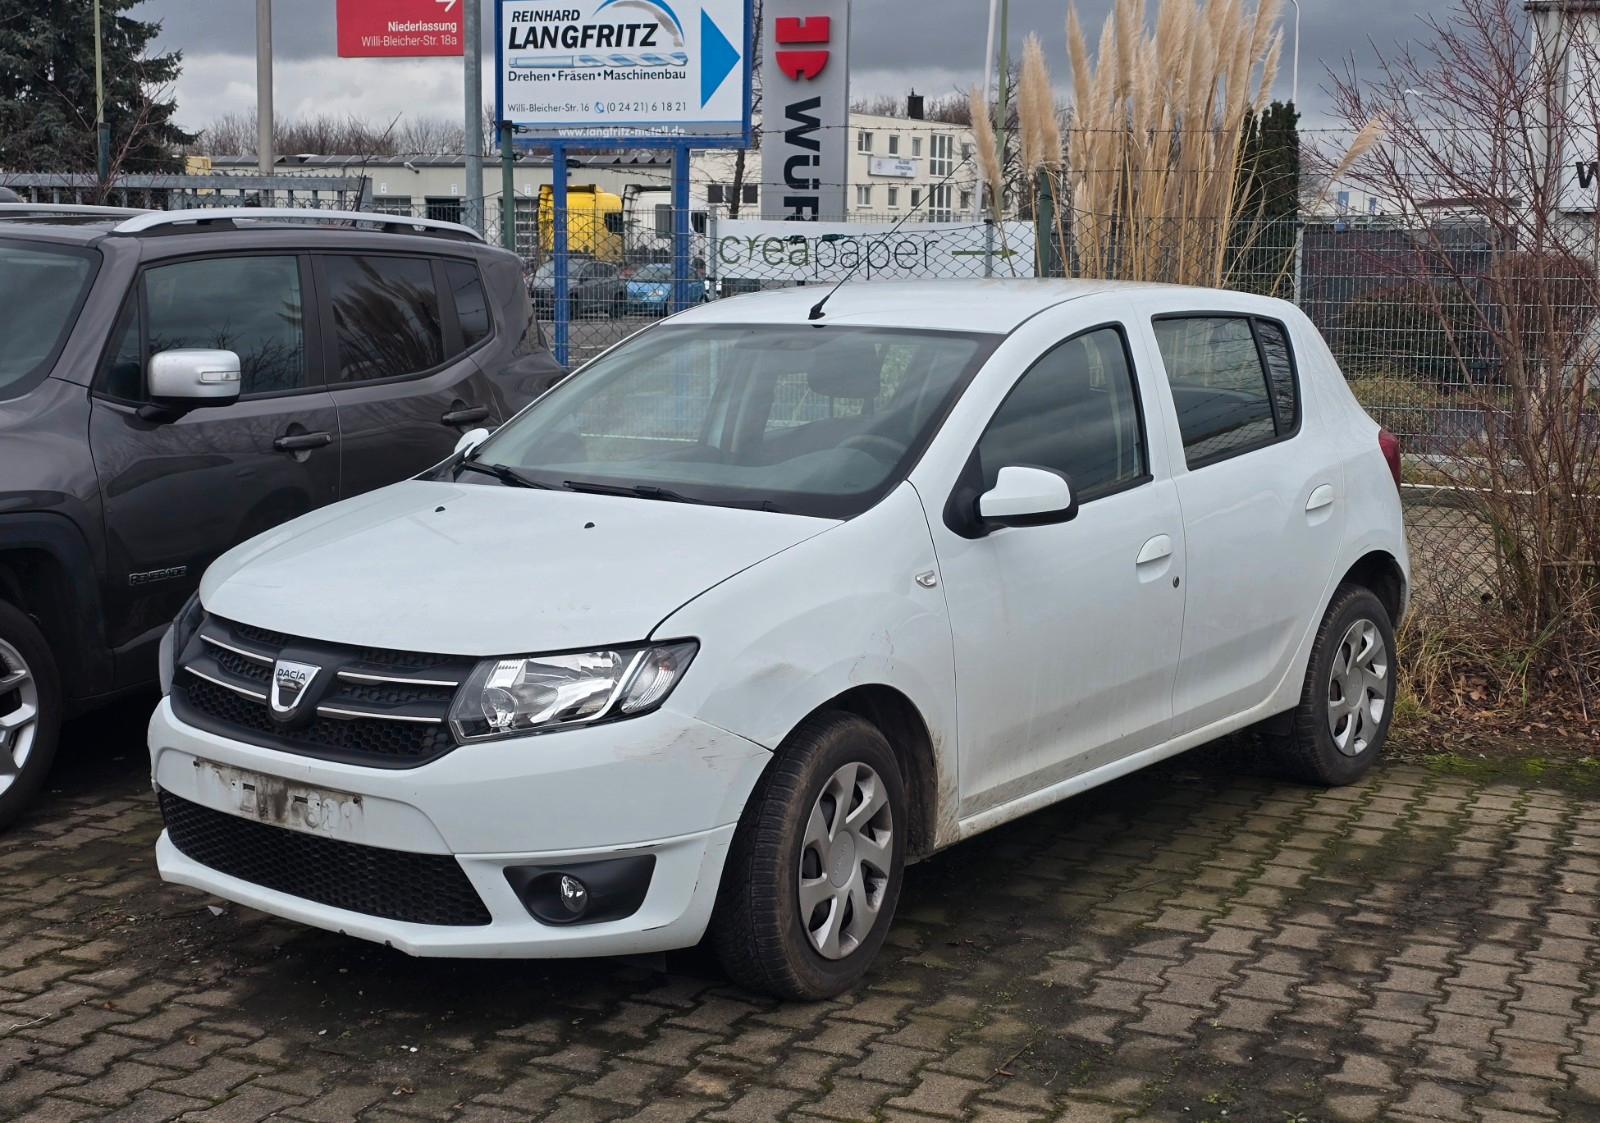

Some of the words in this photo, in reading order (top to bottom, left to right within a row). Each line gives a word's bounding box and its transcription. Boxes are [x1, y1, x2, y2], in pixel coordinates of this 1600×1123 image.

[511, 9, 581, 22] REINHARD
[387, 20, 457, 33] Niederlassung
[361, 34, 438, 47] Willi-Bleicher-Str.
[441, 34, 457, 46] 18a
[508, 23, 659, 49] LANGFRITZ
[508, 71, 550, 82] Drehen
[557, 70, 596, 81] Fräsen
[603, 69, 686, 81] Maschinenbau
[507, 102, 579, 113] Willi-Bleicher-Str.
[580, 102, 590, 112] 16
[619, 102, 631, 112] 24
[651, 102, 658, 112] 6
[661, 102, 673, 111] 18
[675, 102, 687, 111] 21
[719, 233, 939, 281] creapaper
[277, 668, 306, 681] DACIA
